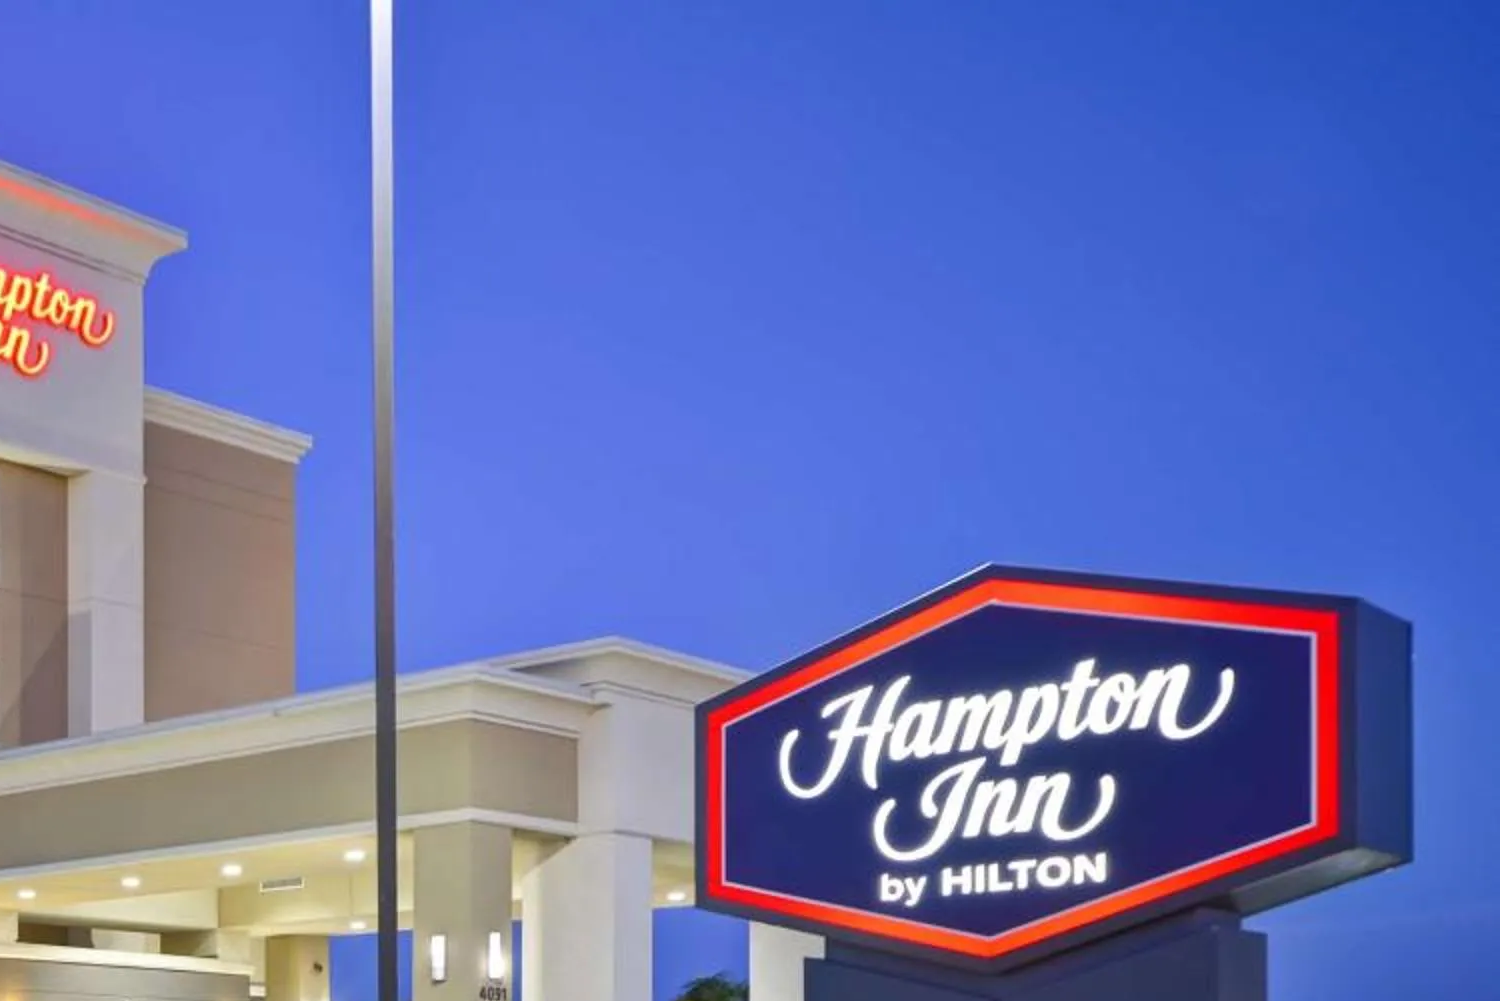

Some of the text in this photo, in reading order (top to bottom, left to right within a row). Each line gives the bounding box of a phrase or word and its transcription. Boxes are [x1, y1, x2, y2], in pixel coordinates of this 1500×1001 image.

[780, 657, 1236, 799] Hampton
[873, 757, 1116, 862] Inn
[879, 852, 1107, 907] by HILTON
